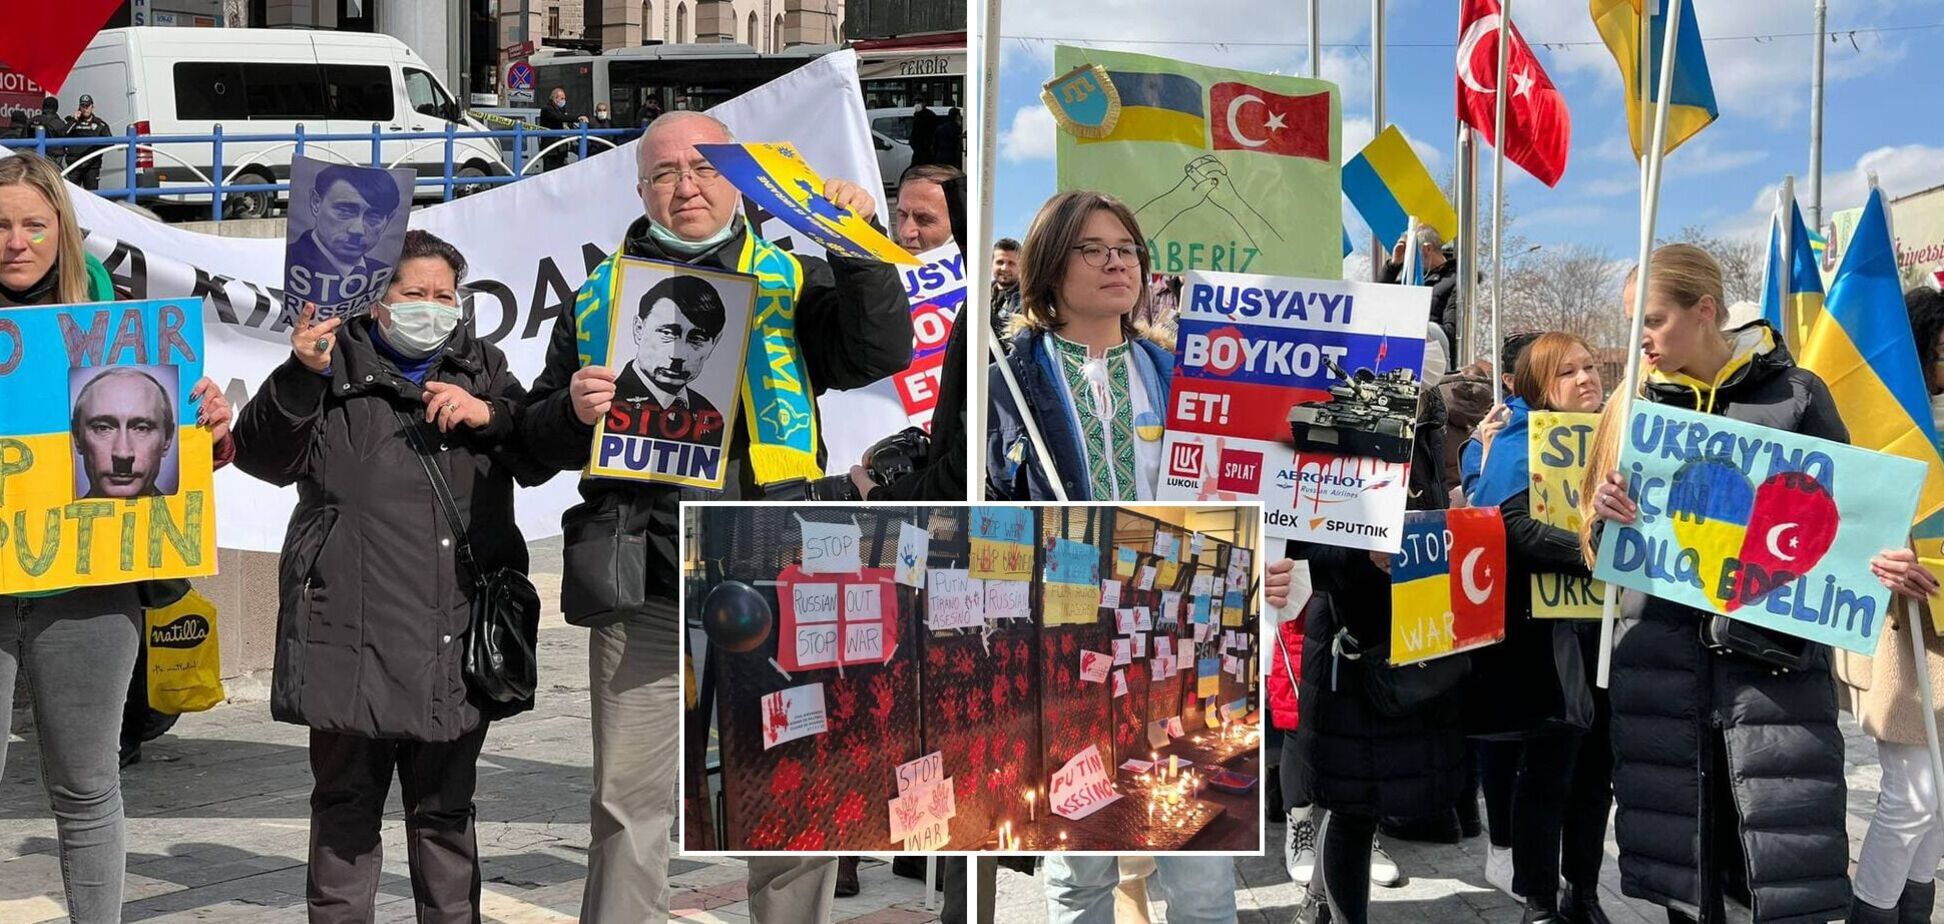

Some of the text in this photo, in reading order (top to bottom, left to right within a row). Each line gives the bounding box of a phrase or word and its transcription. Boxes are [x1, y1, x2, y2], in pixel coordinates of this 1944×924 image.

[289, 264, 393, 302] STOP
[1190, 284, 1354, 324] RUSYA'YI
[57, 305, 196, 365] WAR
[1184, 333, 1347, 380] BOYKOT
[606, 404, 723, 442] STOP
[1177, 391, 1231, 425] ET!
[600, 435, 720, 480] PUTIN
[1225, 462, 1256, 481] SPLAT
[1167, 478, 1199, 489] LUKOIL
[1276, 469, 1366, 488] AEROFLOT
[1331, 489, 1358, 498] Airlines
[806, 535, 853, 560] STOP
[846, 589, 873, 613] OUT
[152, 619, 208, 643] natilla
[798, 627, 879, 657] STOP WAR
[1400, 611, 1457, 652] WAR
[900, 755, 939, 792] STOP
[908, 823, 942, 851] WAR
